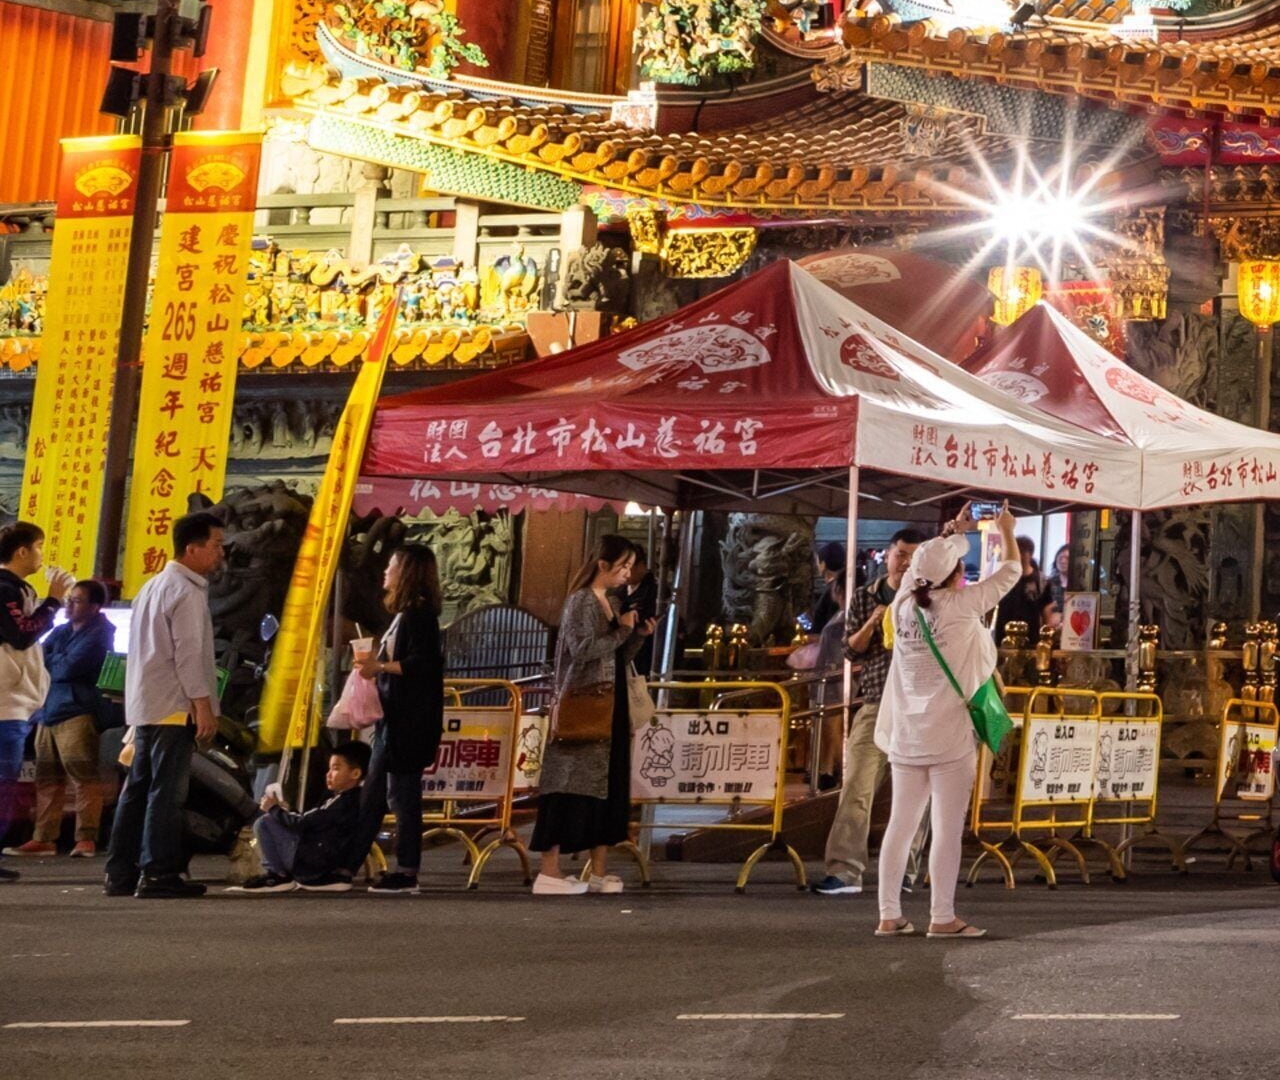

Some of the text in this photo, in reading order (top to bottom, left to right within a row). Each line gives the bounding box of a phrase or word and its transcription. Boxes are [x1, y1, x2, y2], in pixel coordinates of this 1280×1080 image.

[426, 420, 468, 440] 財團
[477, 416, 765, 459] 台北市松山慈祐宮
[424, 444, 468, 463] 法人
[944, 434, 1099, 494] 台北市松山慈祐宮
[688, 721, 729, 735] 出入口
[422, 739, 501, 775] 勿停車
[681, 742, 771, 778] 請勿停車
